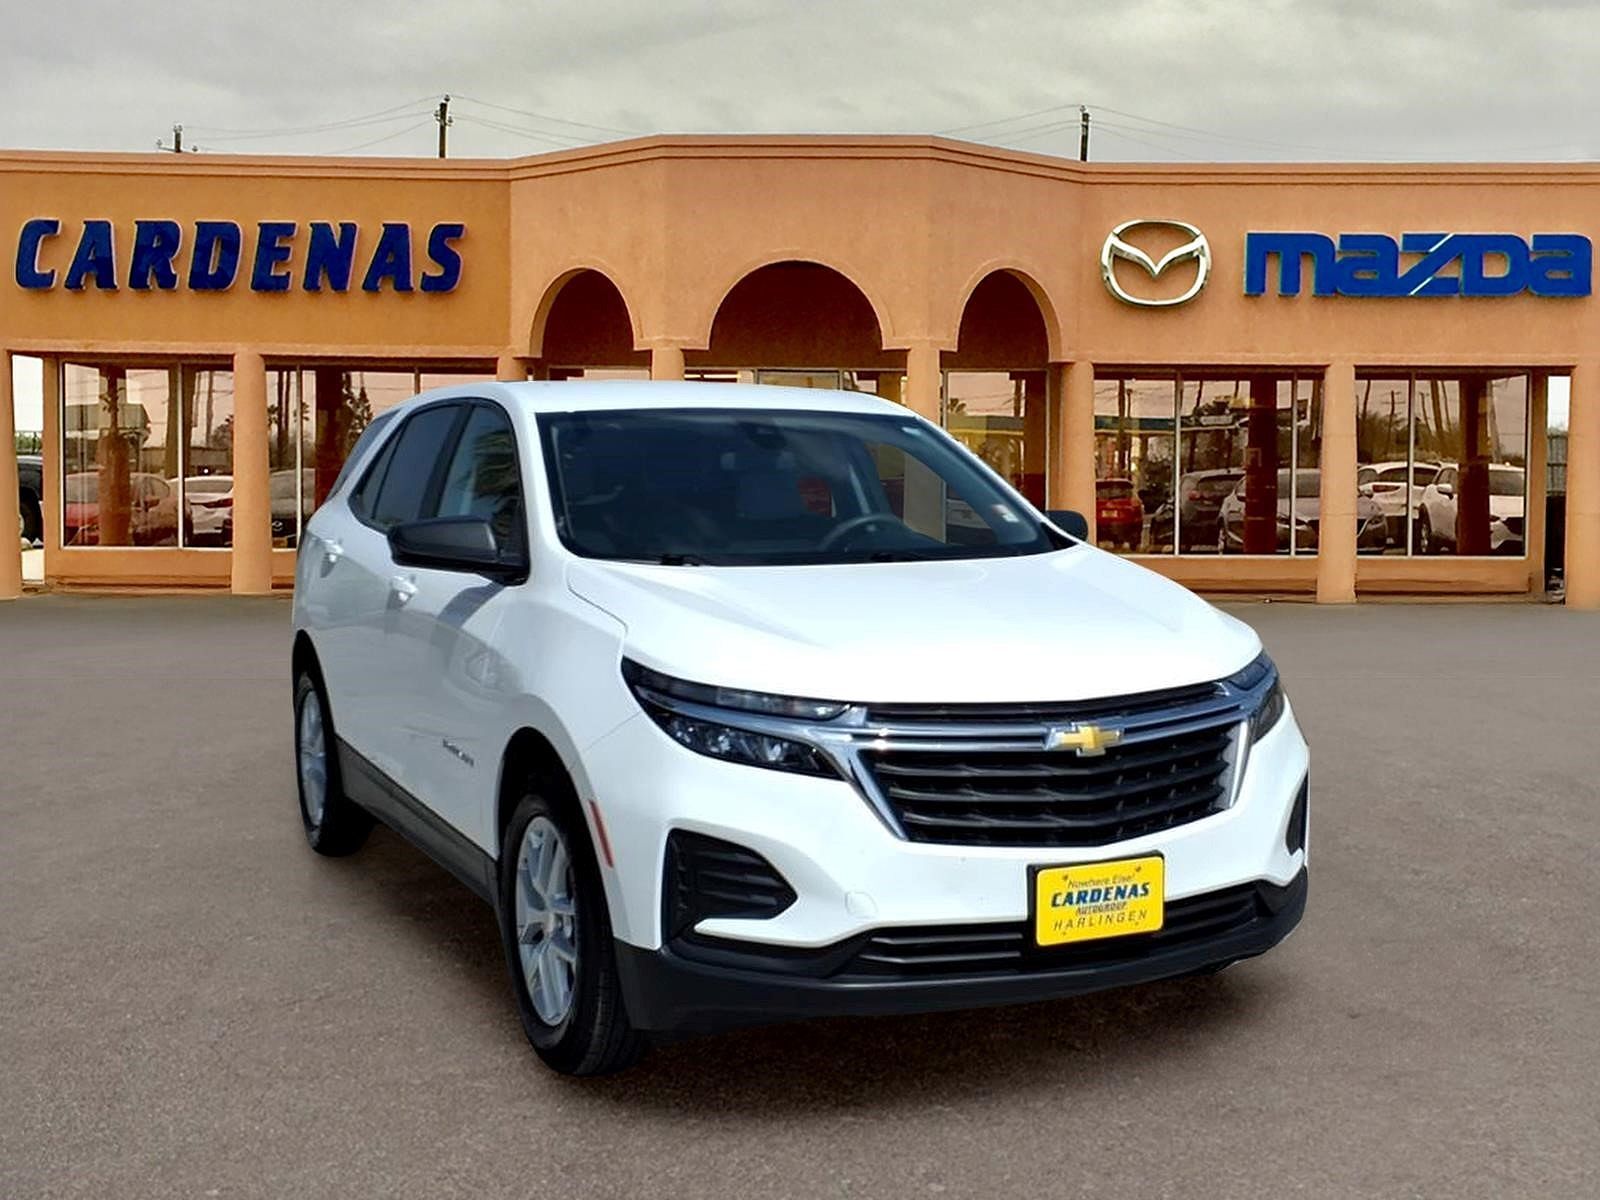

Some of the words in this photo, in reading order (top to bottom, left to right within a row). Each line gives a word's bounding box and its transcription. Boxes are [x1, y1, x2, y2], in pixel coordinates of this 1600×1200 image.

[14, 218, 467, 293] CARDENAS
[1051, 882, 1149, 907] CARDENAS
[1053, 909, 1148, 931] HARLINGEN
